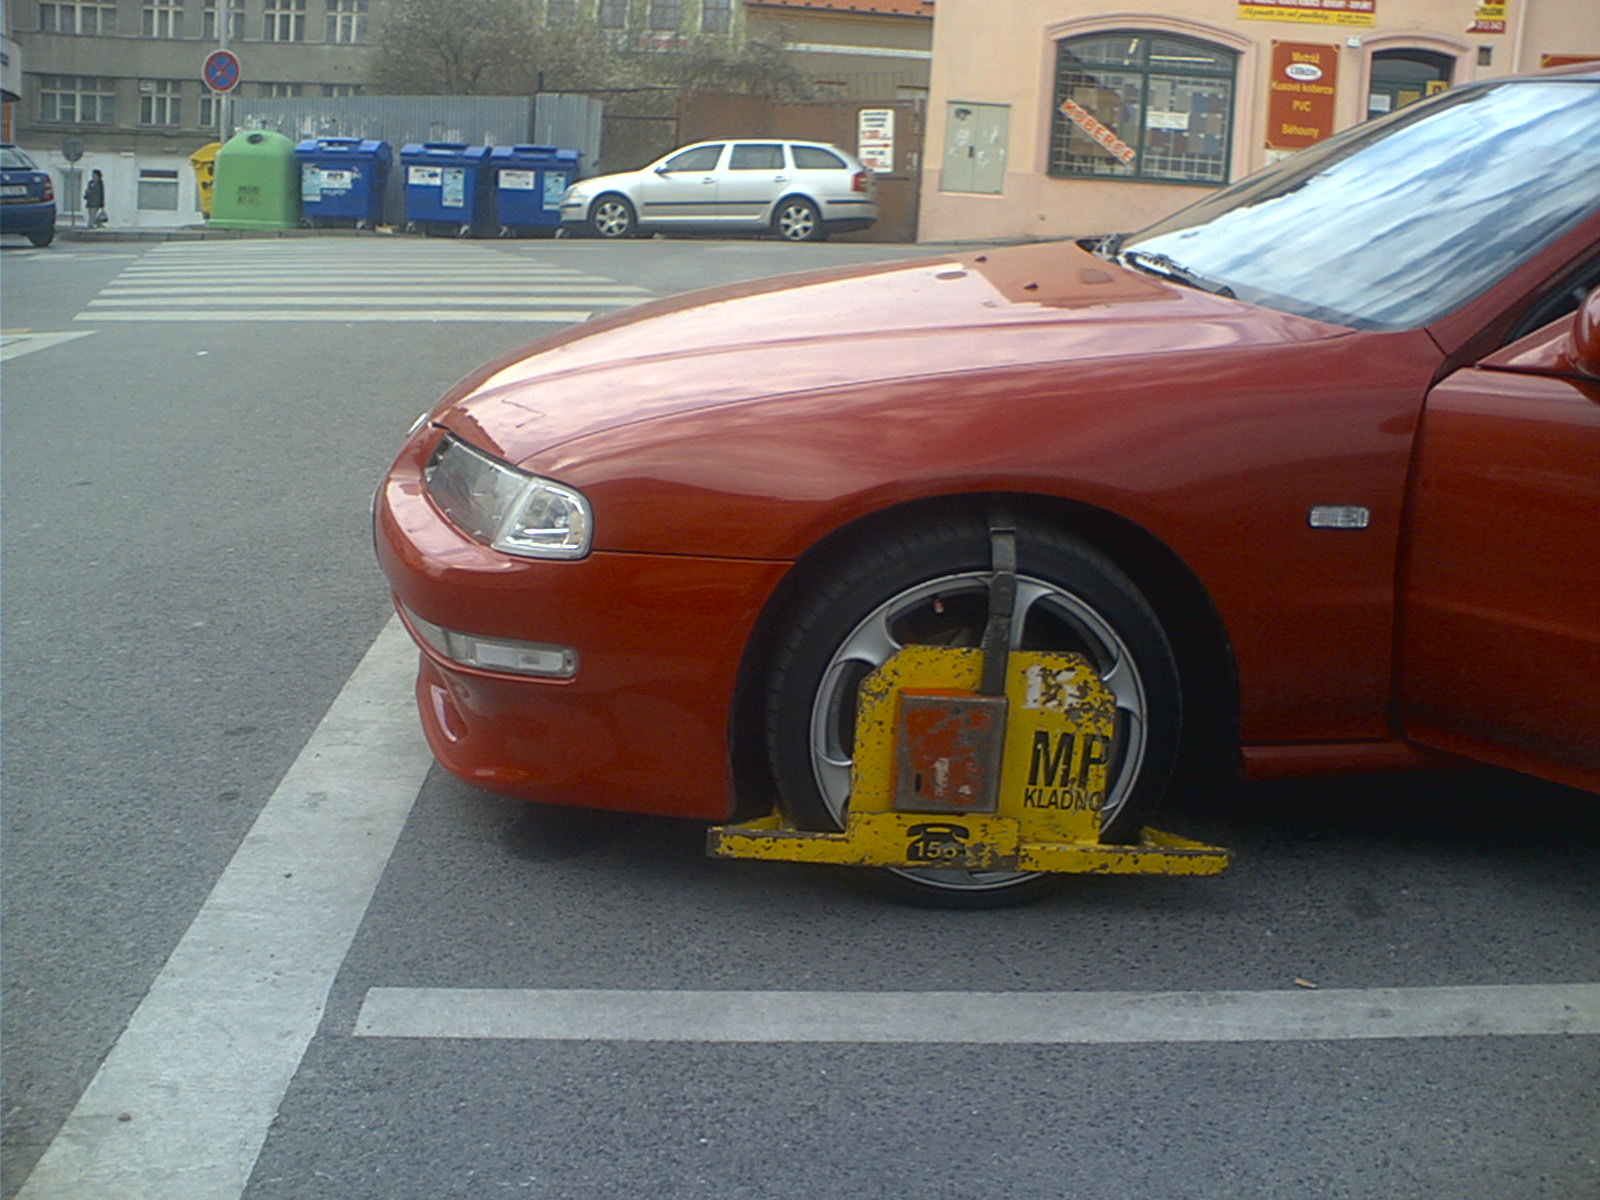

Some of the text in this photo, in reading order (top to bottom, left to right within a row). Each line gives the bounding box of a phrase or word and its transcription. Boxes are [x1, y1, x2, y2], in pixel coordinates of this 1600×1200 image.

[1292, 100, 1312, 112] PVC
[1027, 730, 1111, 788] MP
[1023, 787, 1106, 812] KLADNO
